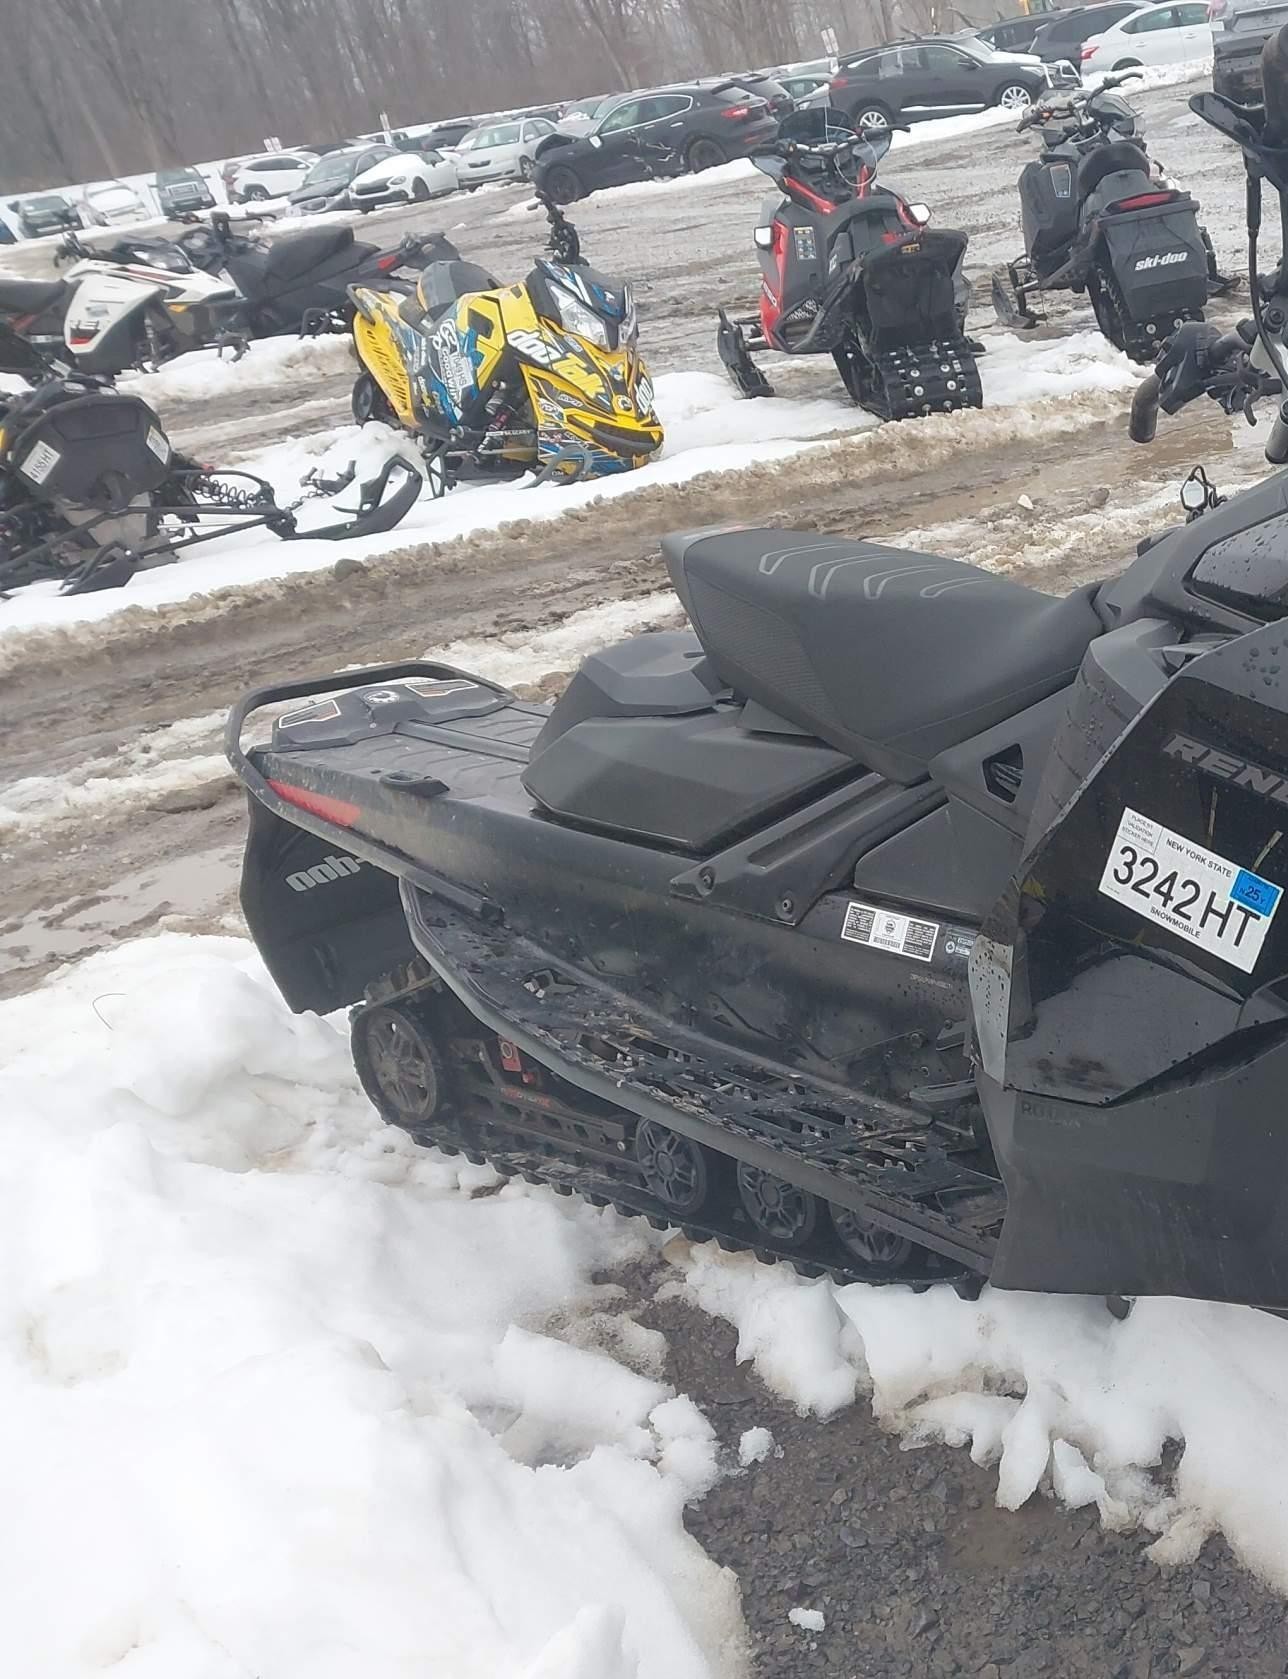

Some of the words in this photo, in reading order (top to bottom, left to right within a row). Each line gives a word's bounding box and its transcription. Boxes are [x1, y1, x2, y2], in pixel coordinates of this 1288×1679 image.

[1134, 251, 1189, 272] ski-doo
[1166, 838, 1186, 854] NEW
[1185, 847, 1207, 865] YORK
[1207, 860, 1234, 878] STATE
[1245, 885, 1261, 901] 25
[1150, 906, 1202, 939] SNOWMOBILE
